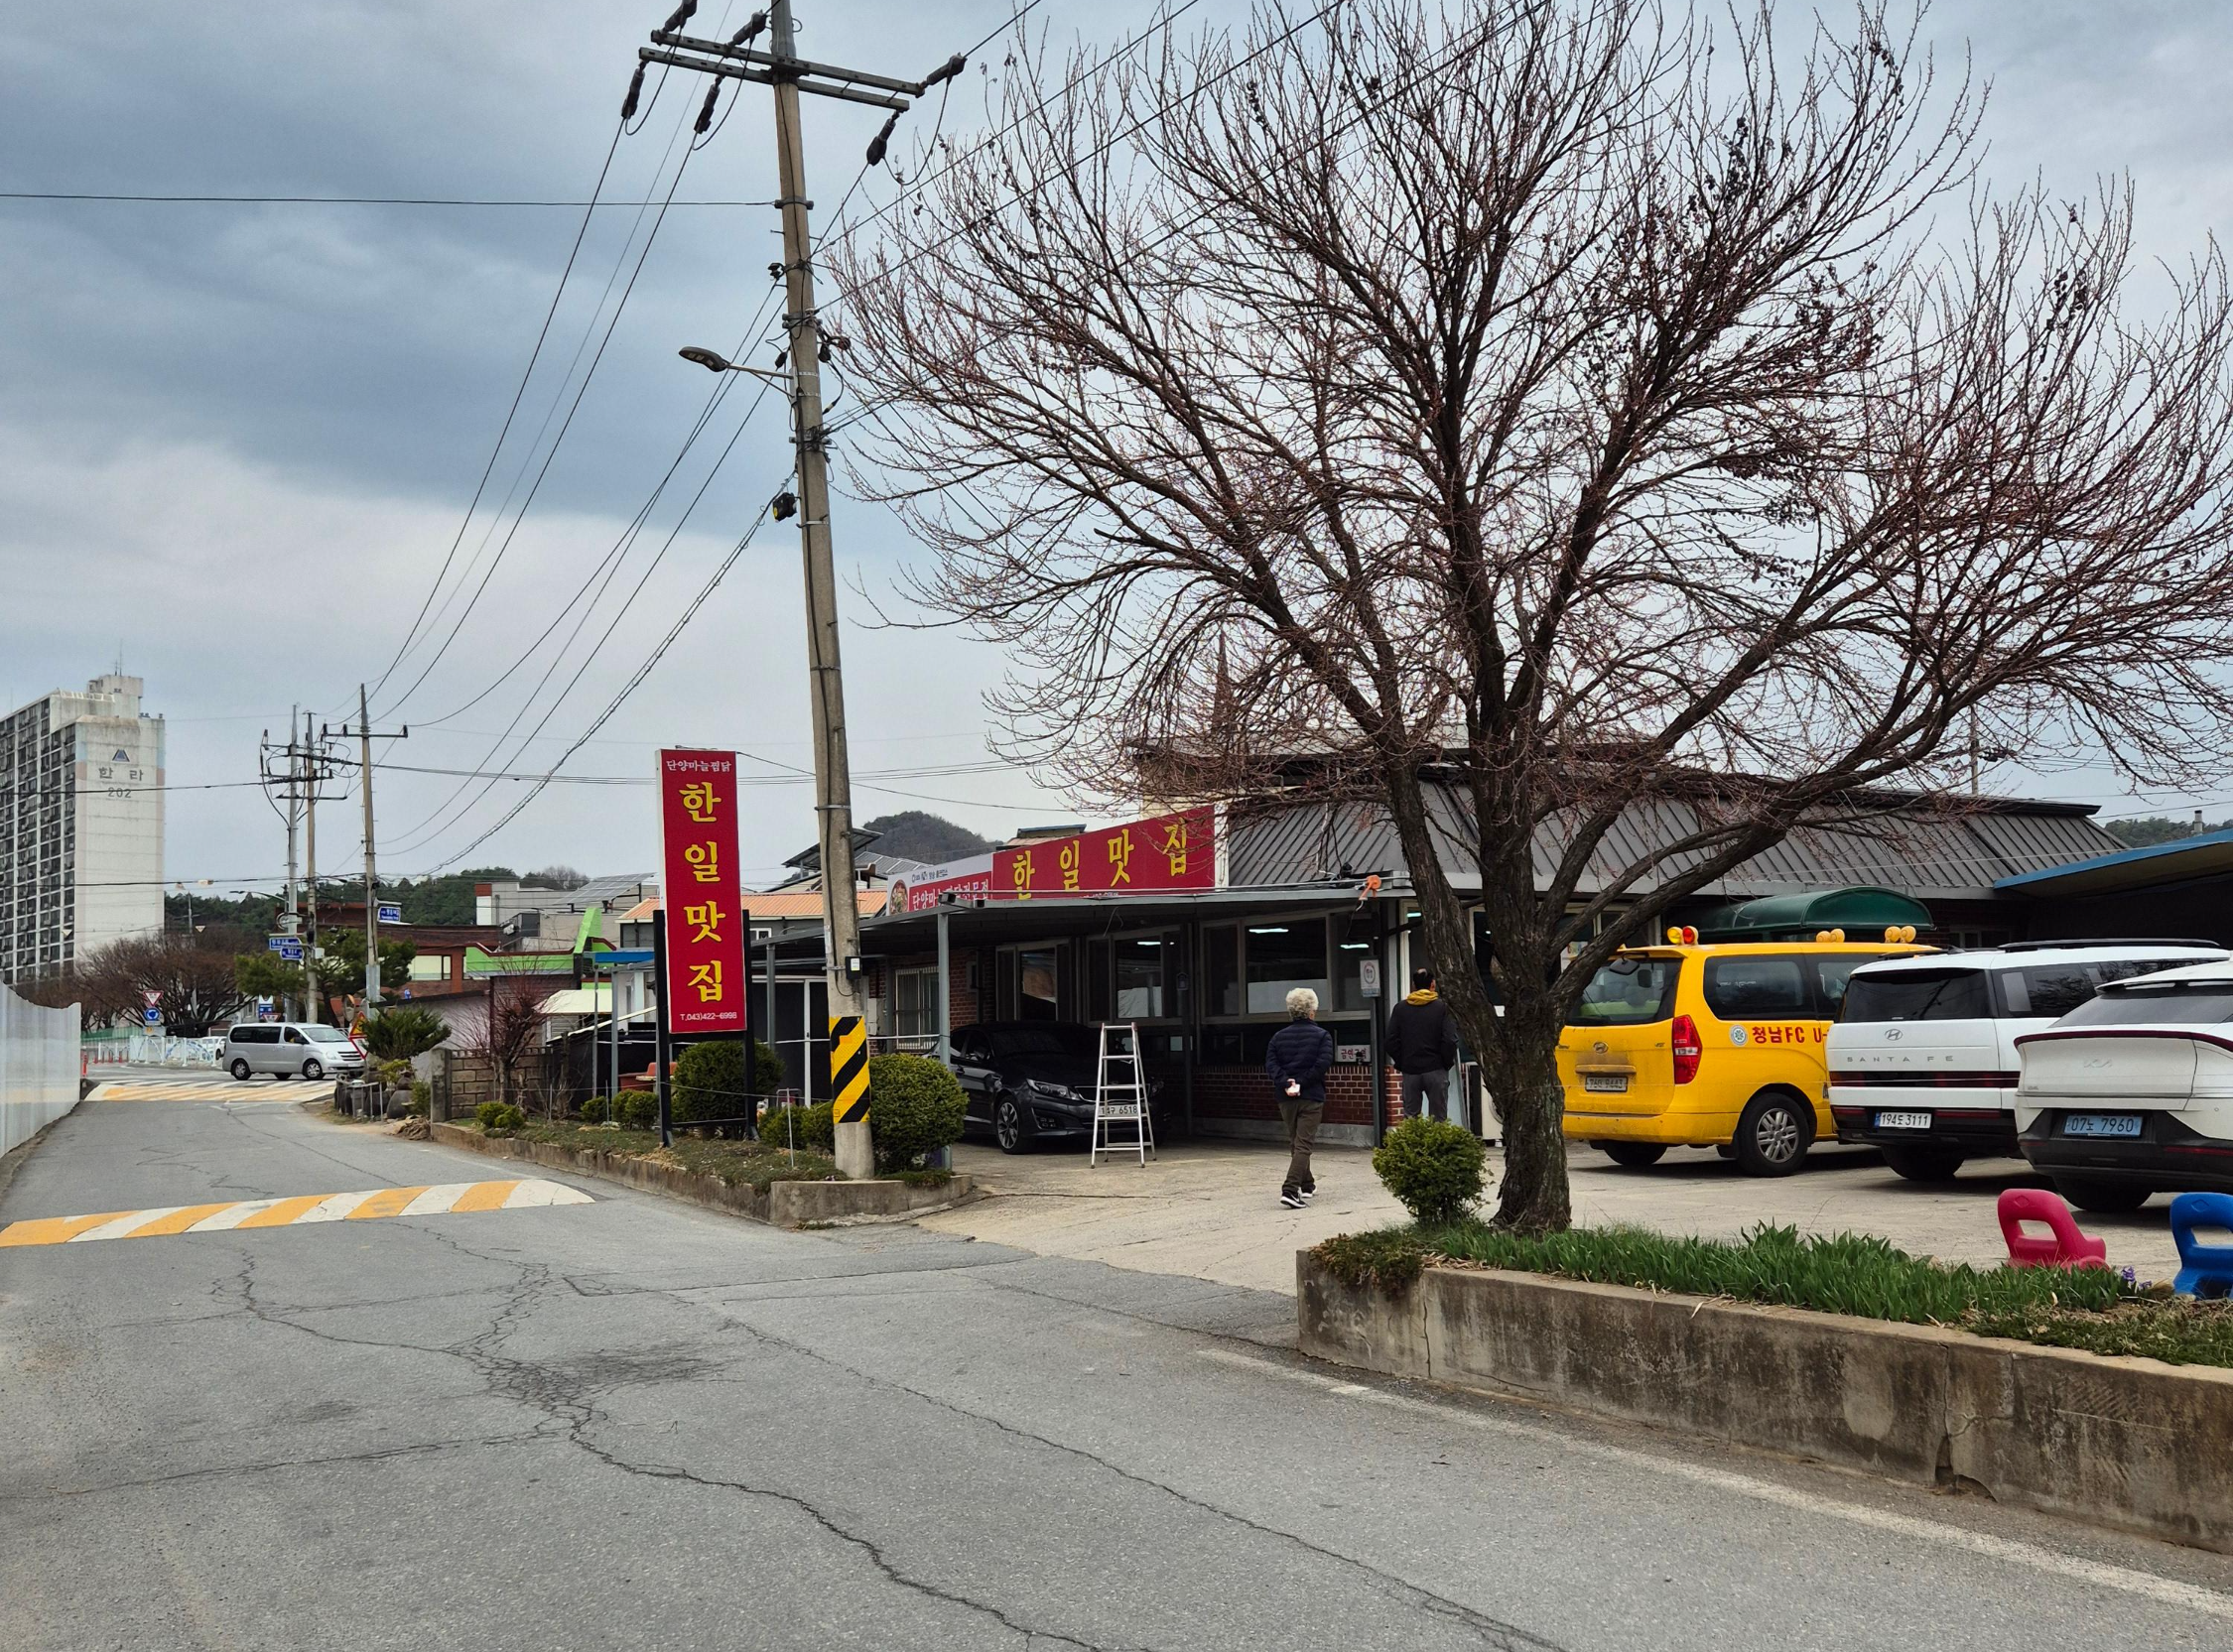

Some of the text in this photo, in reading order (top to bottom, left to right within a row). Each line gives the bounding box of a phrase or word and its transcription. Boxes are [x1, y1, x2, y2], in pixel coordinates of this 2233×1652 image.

[666, 759, 732, 773] 단양마늘찜닭
[107, 787, 132, 799] 202
[679, 781, 726, 1002] 한일맛집
[1118, 1105, 1138, 1115] 6518
[1905, 1114, 1929, 1127] 3111
[2070, 1117, 2135, 1133] 07노 7960
